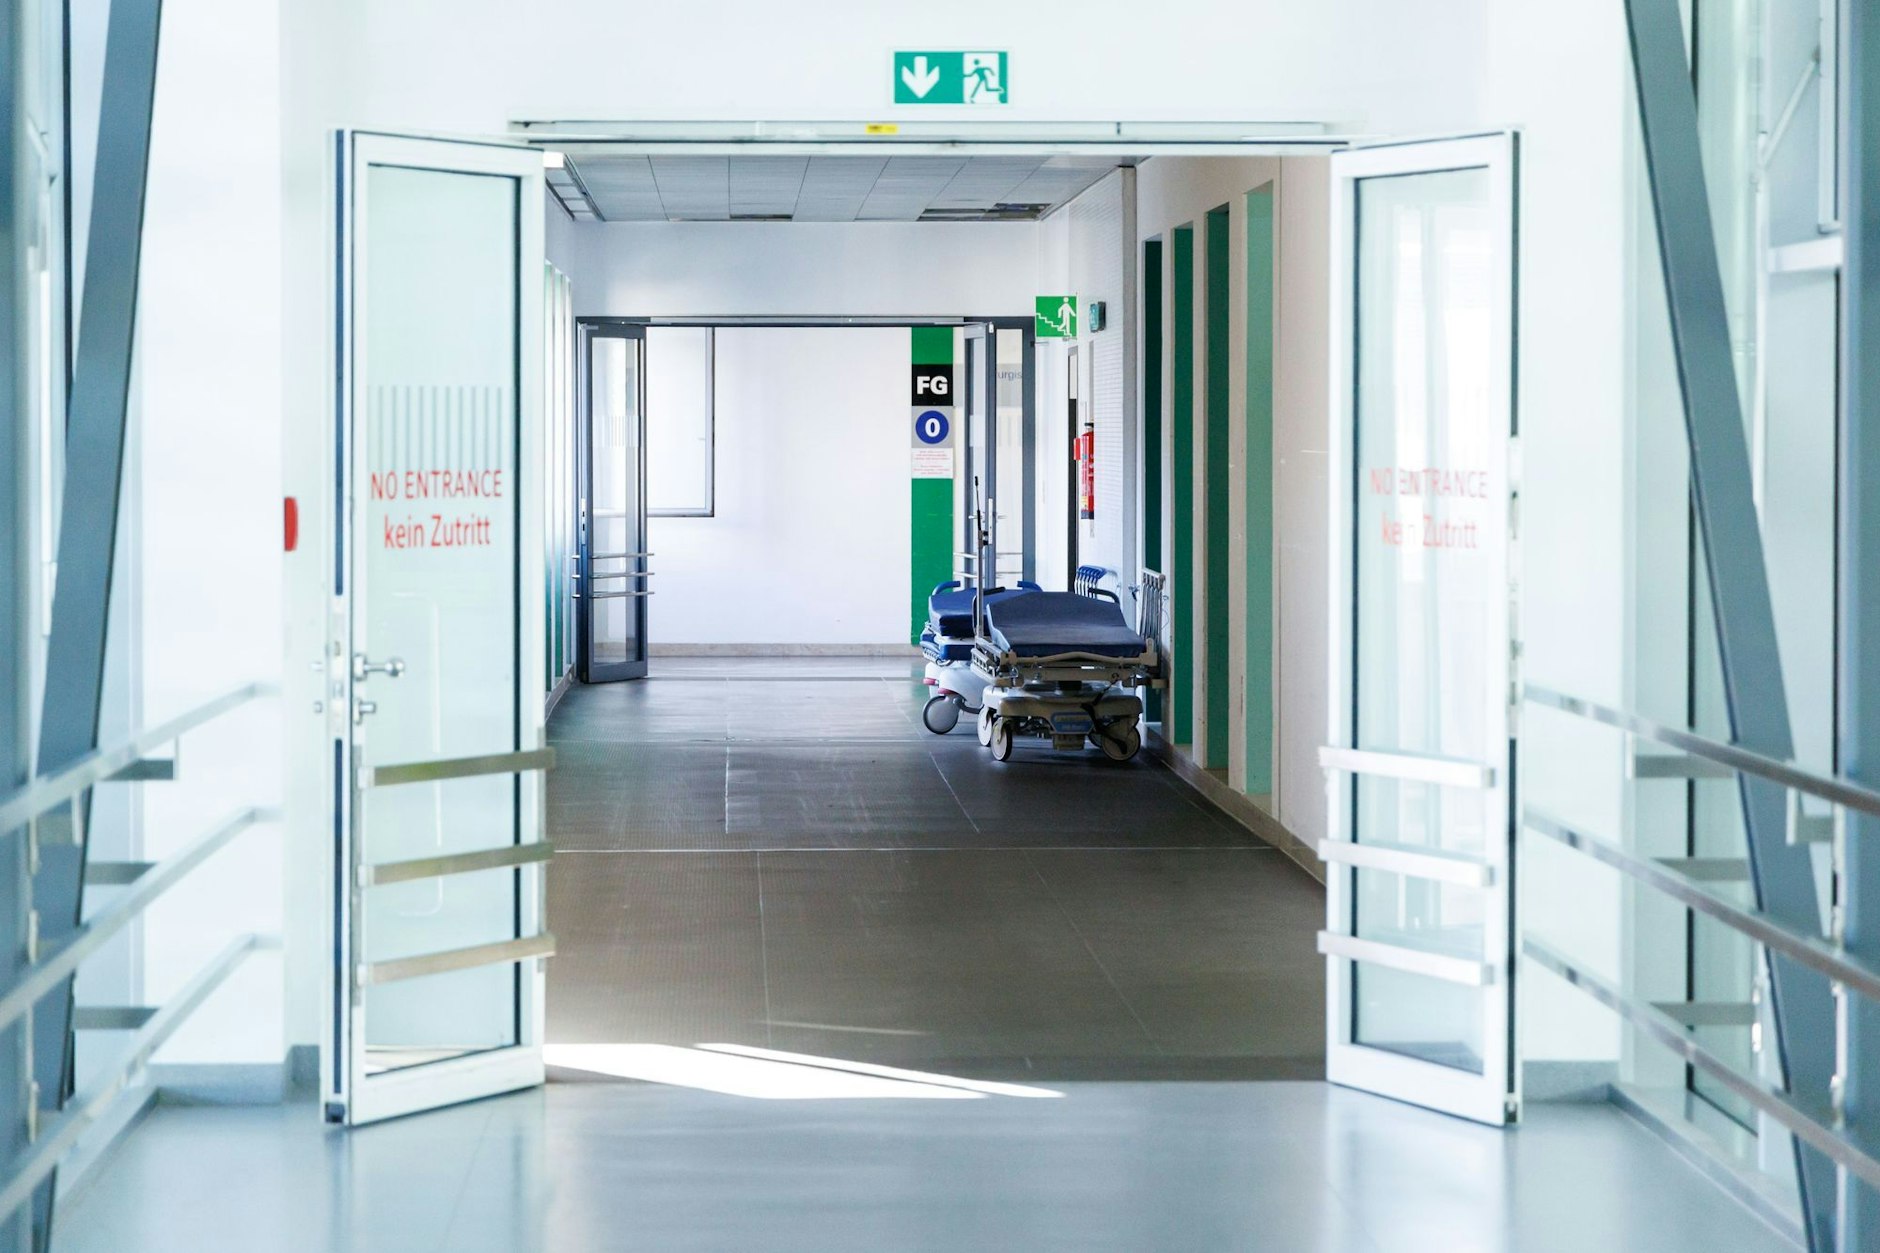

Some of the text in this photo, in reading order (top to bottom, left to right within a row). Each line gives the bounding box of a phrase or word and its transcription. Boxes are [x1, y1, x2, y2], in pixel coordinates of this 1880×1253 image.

[916, 375, 949, 395] FG
[925, 418, 941, 437] 0
[371, 469, 502, 500] NO ENTRANCE
[1371, 467, 1488, 499] NO ENTRANCE
[384, 513, 490, 548] kein Zutritt
[1382, 512, 1477, 549] ken Zutritt
